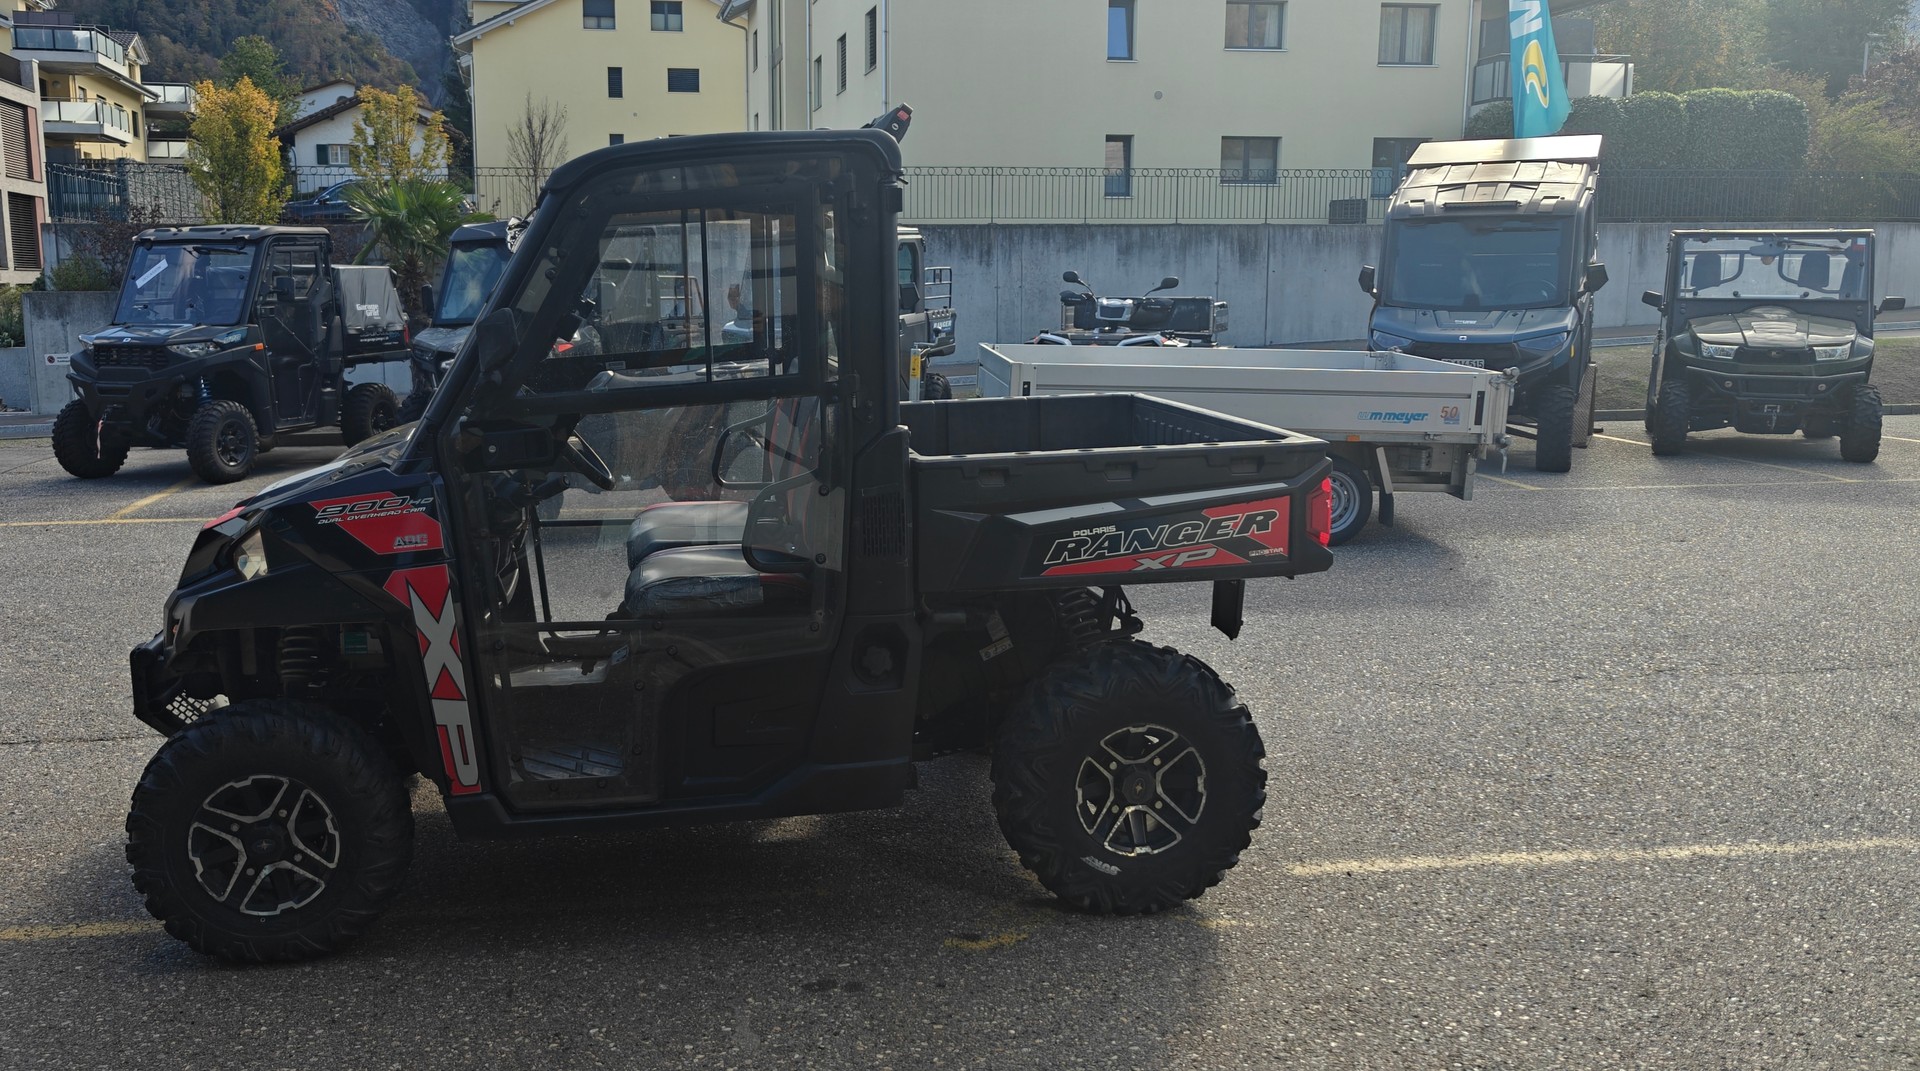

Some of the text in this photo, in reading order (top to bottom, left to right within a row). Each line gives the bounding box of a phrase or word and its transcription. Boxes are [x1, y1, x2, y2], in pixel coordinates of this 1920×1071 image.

[315, 496, 410, 519] 900
[318, 517, 345, 525] DUAL
[347, 510, 402, 521] OVERHEAD
[1043, 509, 1280, 565] RANGER
[1073, 525, 1117, 538] POLARIS
[1130, 548, 1219, 572] XP
[1249, 547, 1284, 557] PROSTAR
[406, 578, 480, 788] XP
